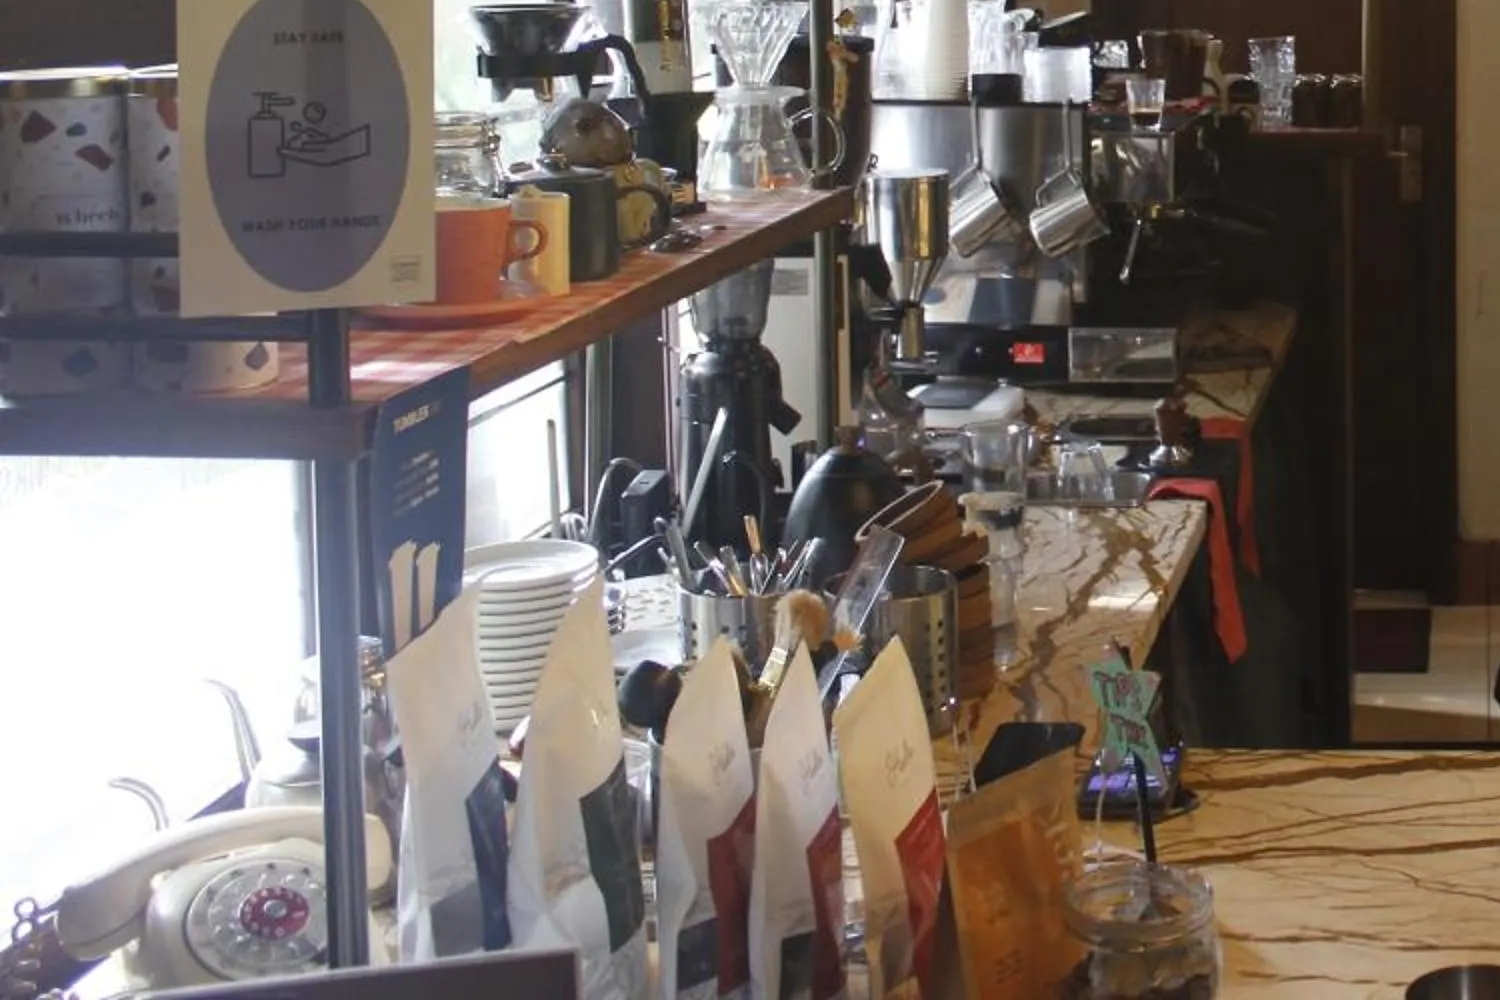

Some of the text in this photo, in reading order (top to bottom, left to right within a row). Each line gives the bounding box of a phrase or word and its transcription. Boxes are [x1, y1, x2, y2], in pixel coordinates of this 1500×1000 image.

[273, 29, 344, 45] STAY SAFE
[242, 214, 381, 233] WASH YOUR HANDS
